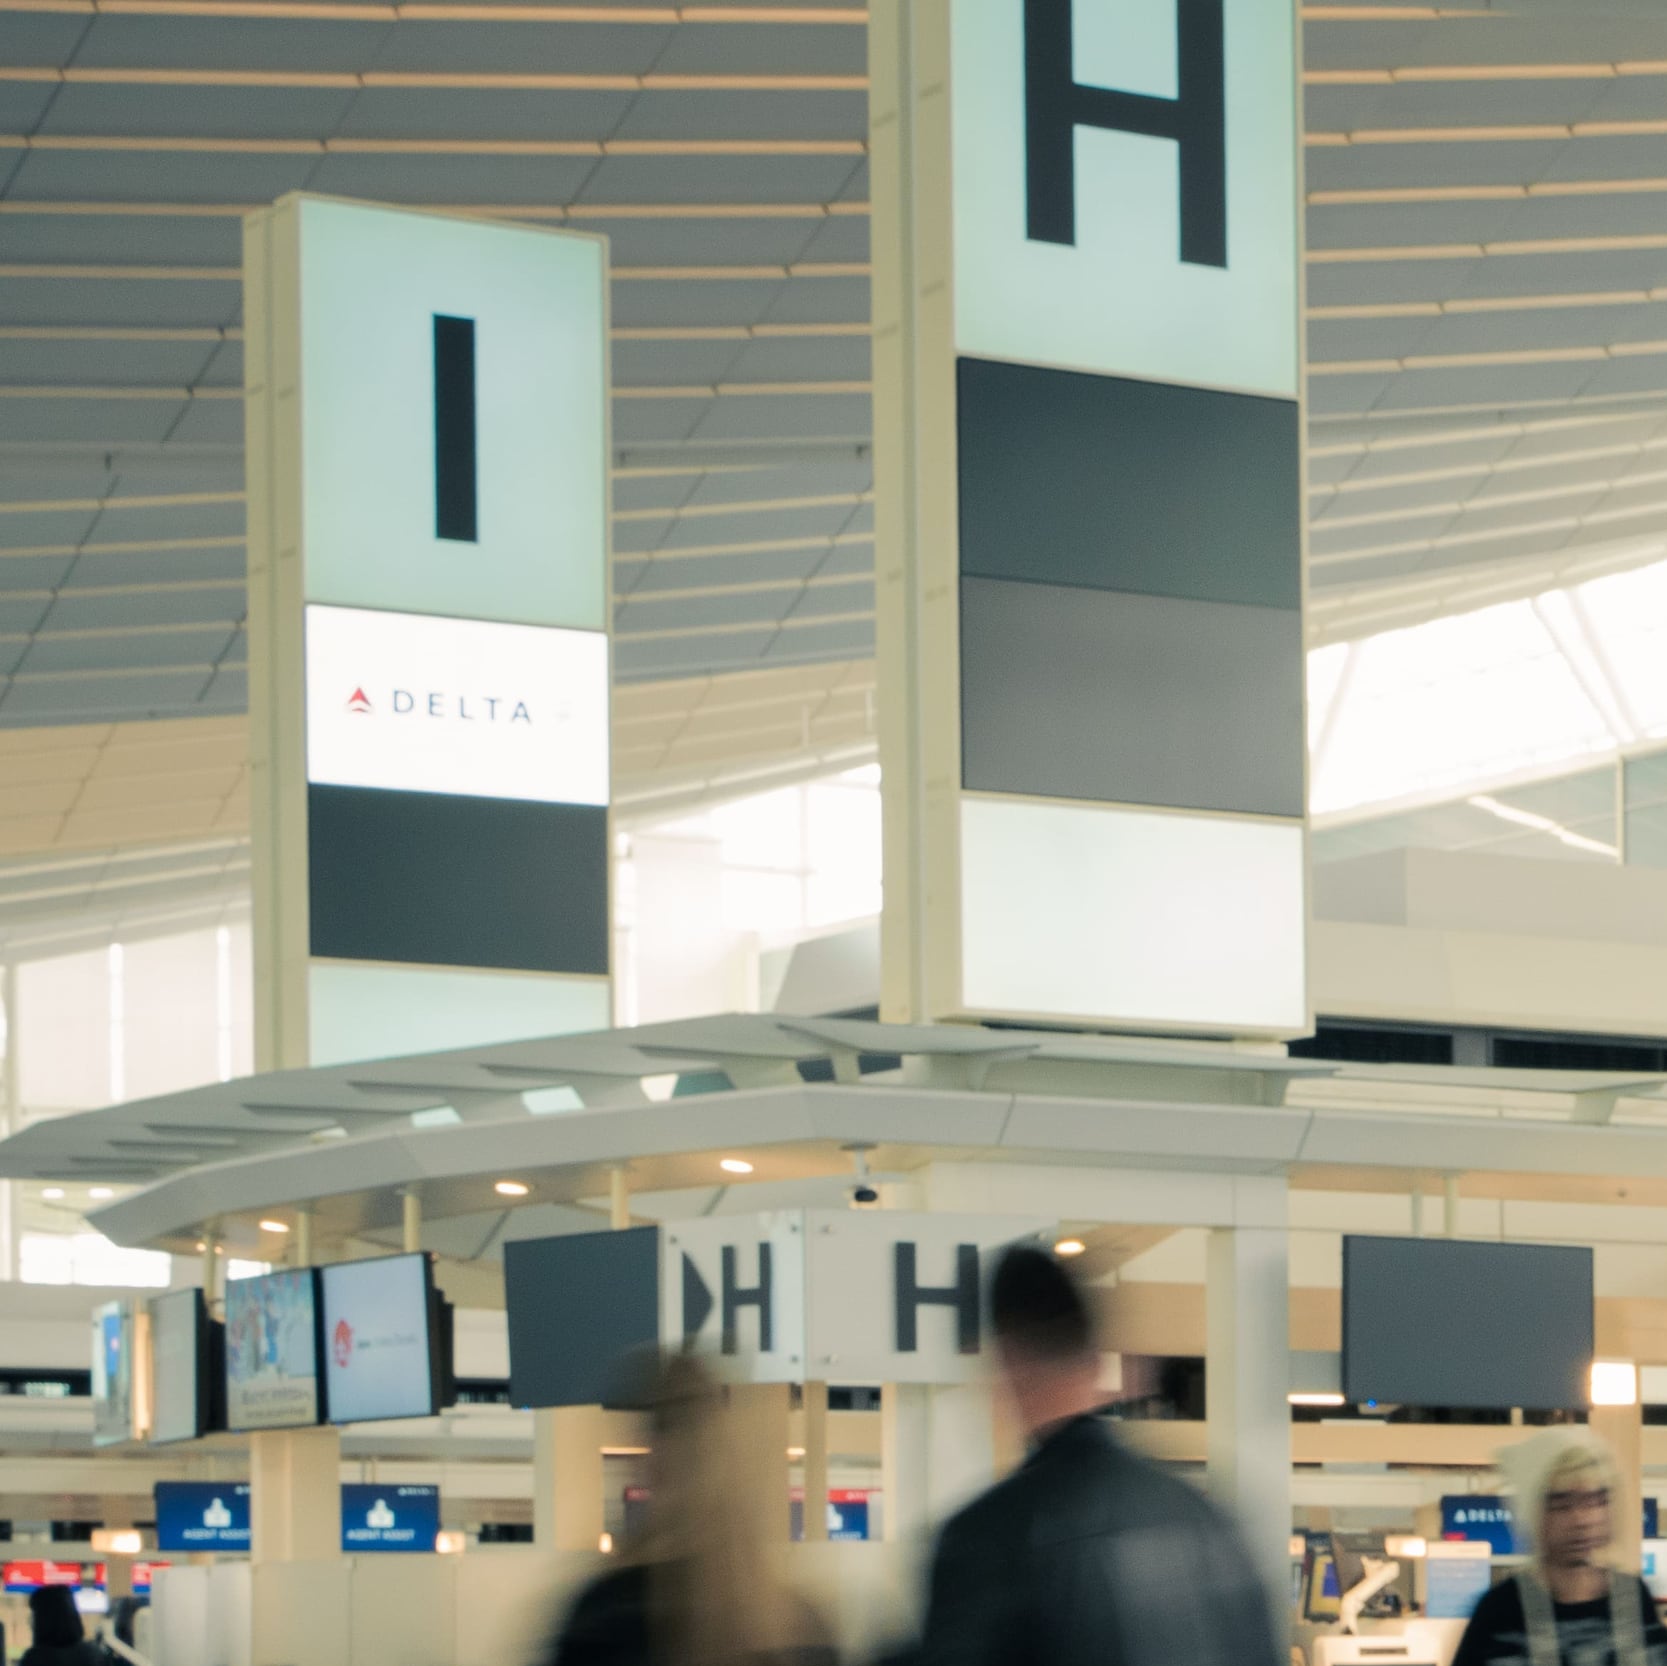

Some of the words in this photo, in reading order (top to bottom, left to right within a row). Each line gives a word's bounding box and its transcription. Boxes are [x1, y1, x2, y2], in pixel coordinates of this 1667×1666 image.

[1024, 0, 1228, 269] H
[393, 690, 532, 724] DELTA
[722, 1241, 771, 1355] H
[895, 1241, 980, 1353] H
[1466, 1509, 1512, 1523] DELTA
